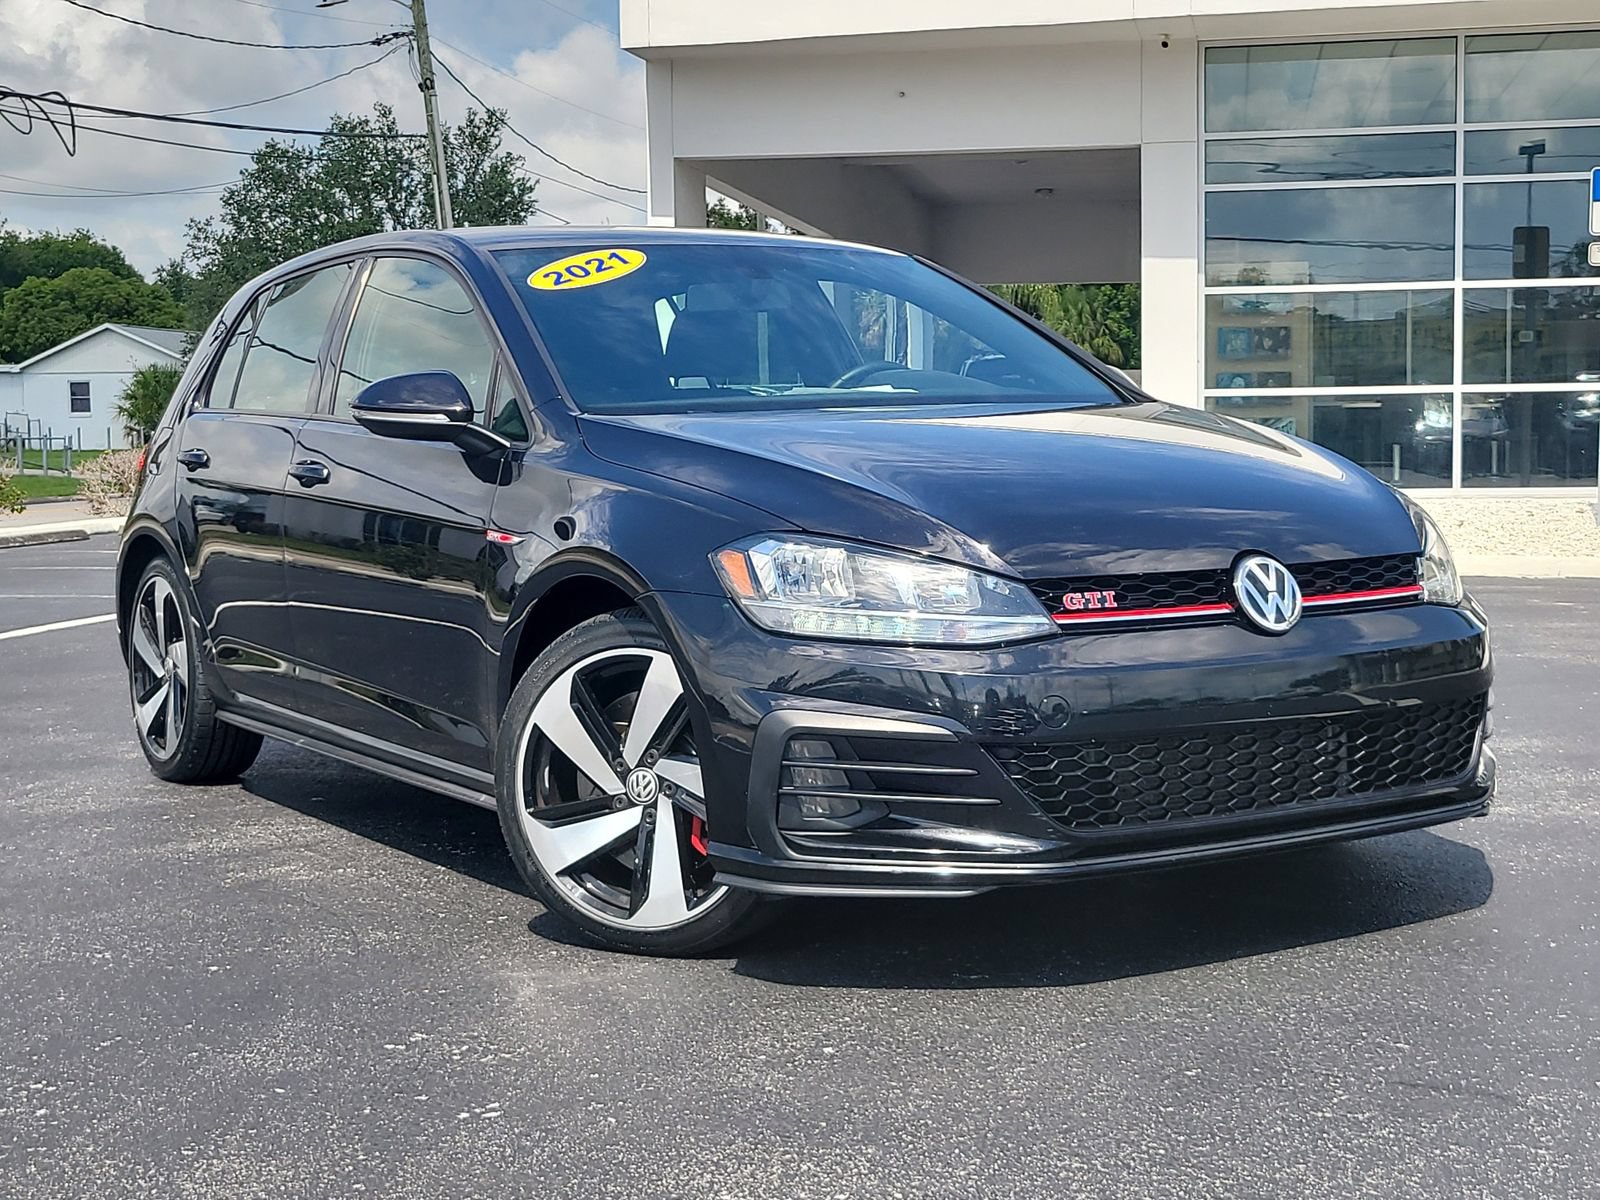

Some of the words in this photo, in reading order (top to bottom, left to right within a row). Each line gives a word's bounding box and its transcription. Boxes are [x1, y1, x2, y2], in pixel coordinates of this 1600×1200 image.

[543, 252, 631, 286] 2021
[1063, 591, 1118, 610] GTI
[1236, 557, 1301, 631] VW
[628, 769, 658, 803] VW
